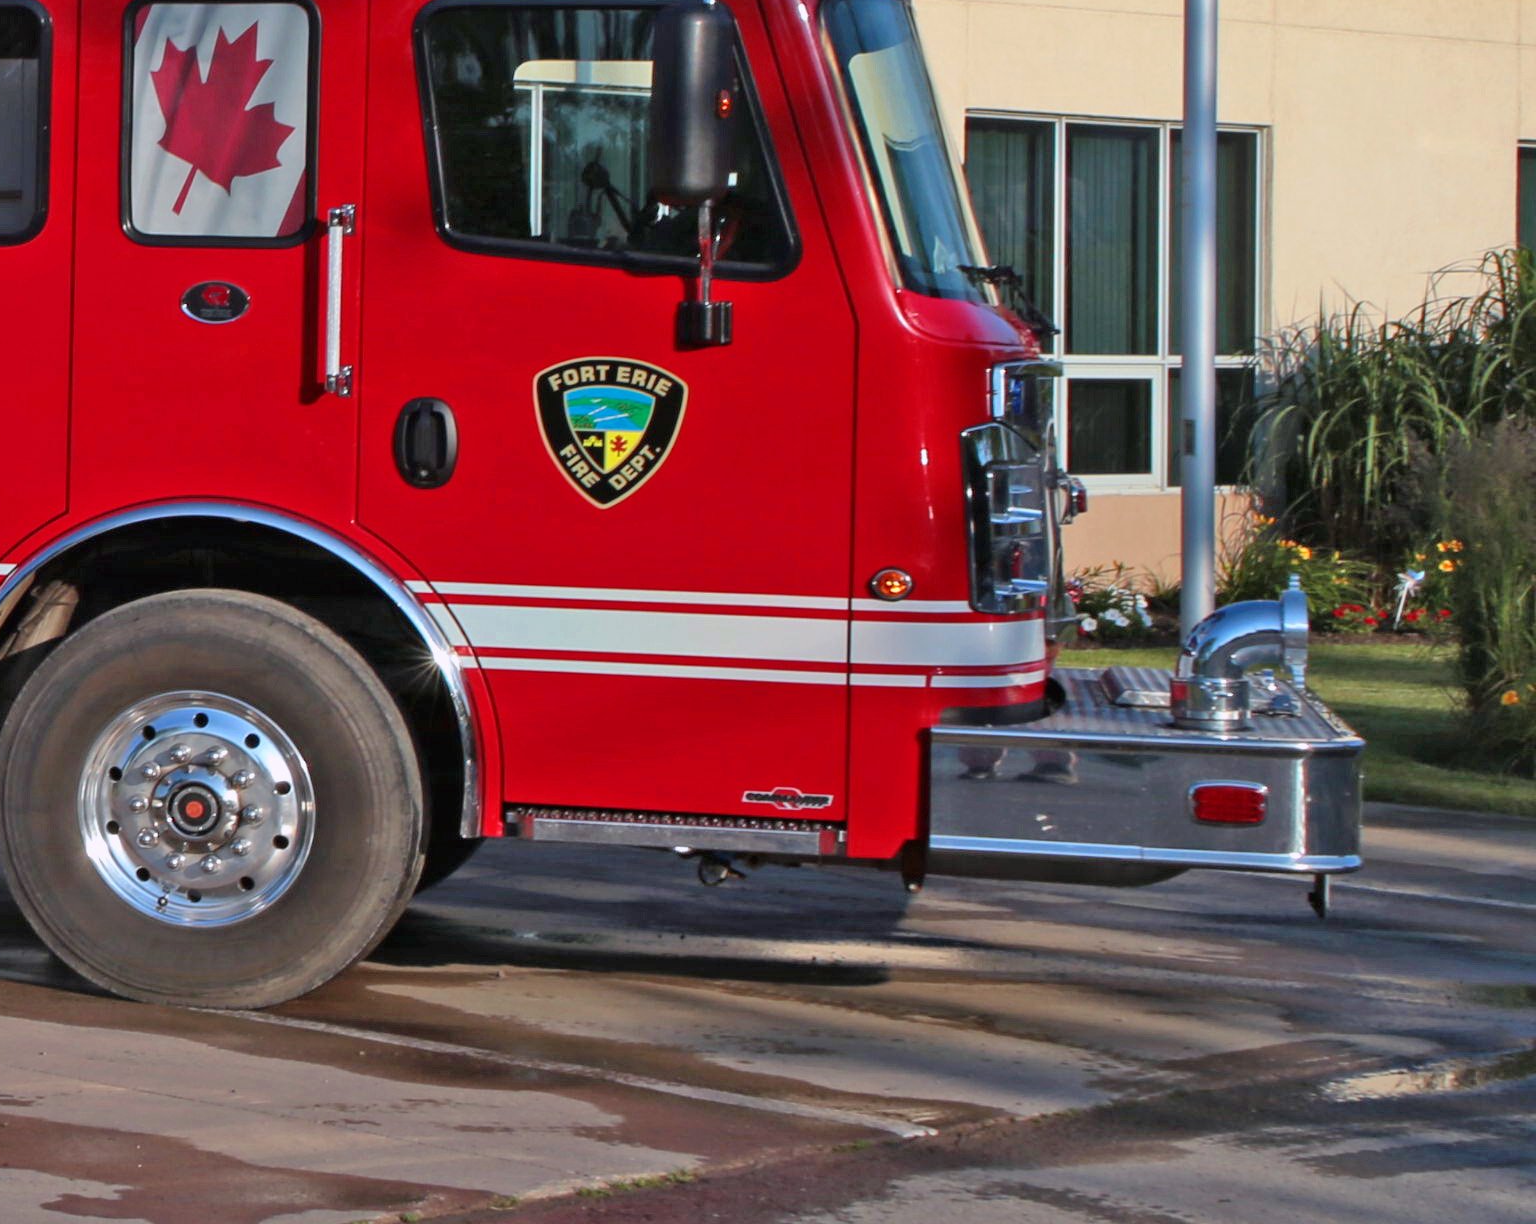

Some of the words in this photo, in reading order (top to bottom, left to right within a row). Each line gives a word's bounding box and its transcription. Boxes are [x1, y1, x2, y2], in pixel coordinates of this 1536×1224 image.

[547, 364, 611, 393] FORT
[615, 365, 674, 398] ERIE
[559, 443, 601, 489] FIRE
[608, 444, 662, 492] DEPT.
